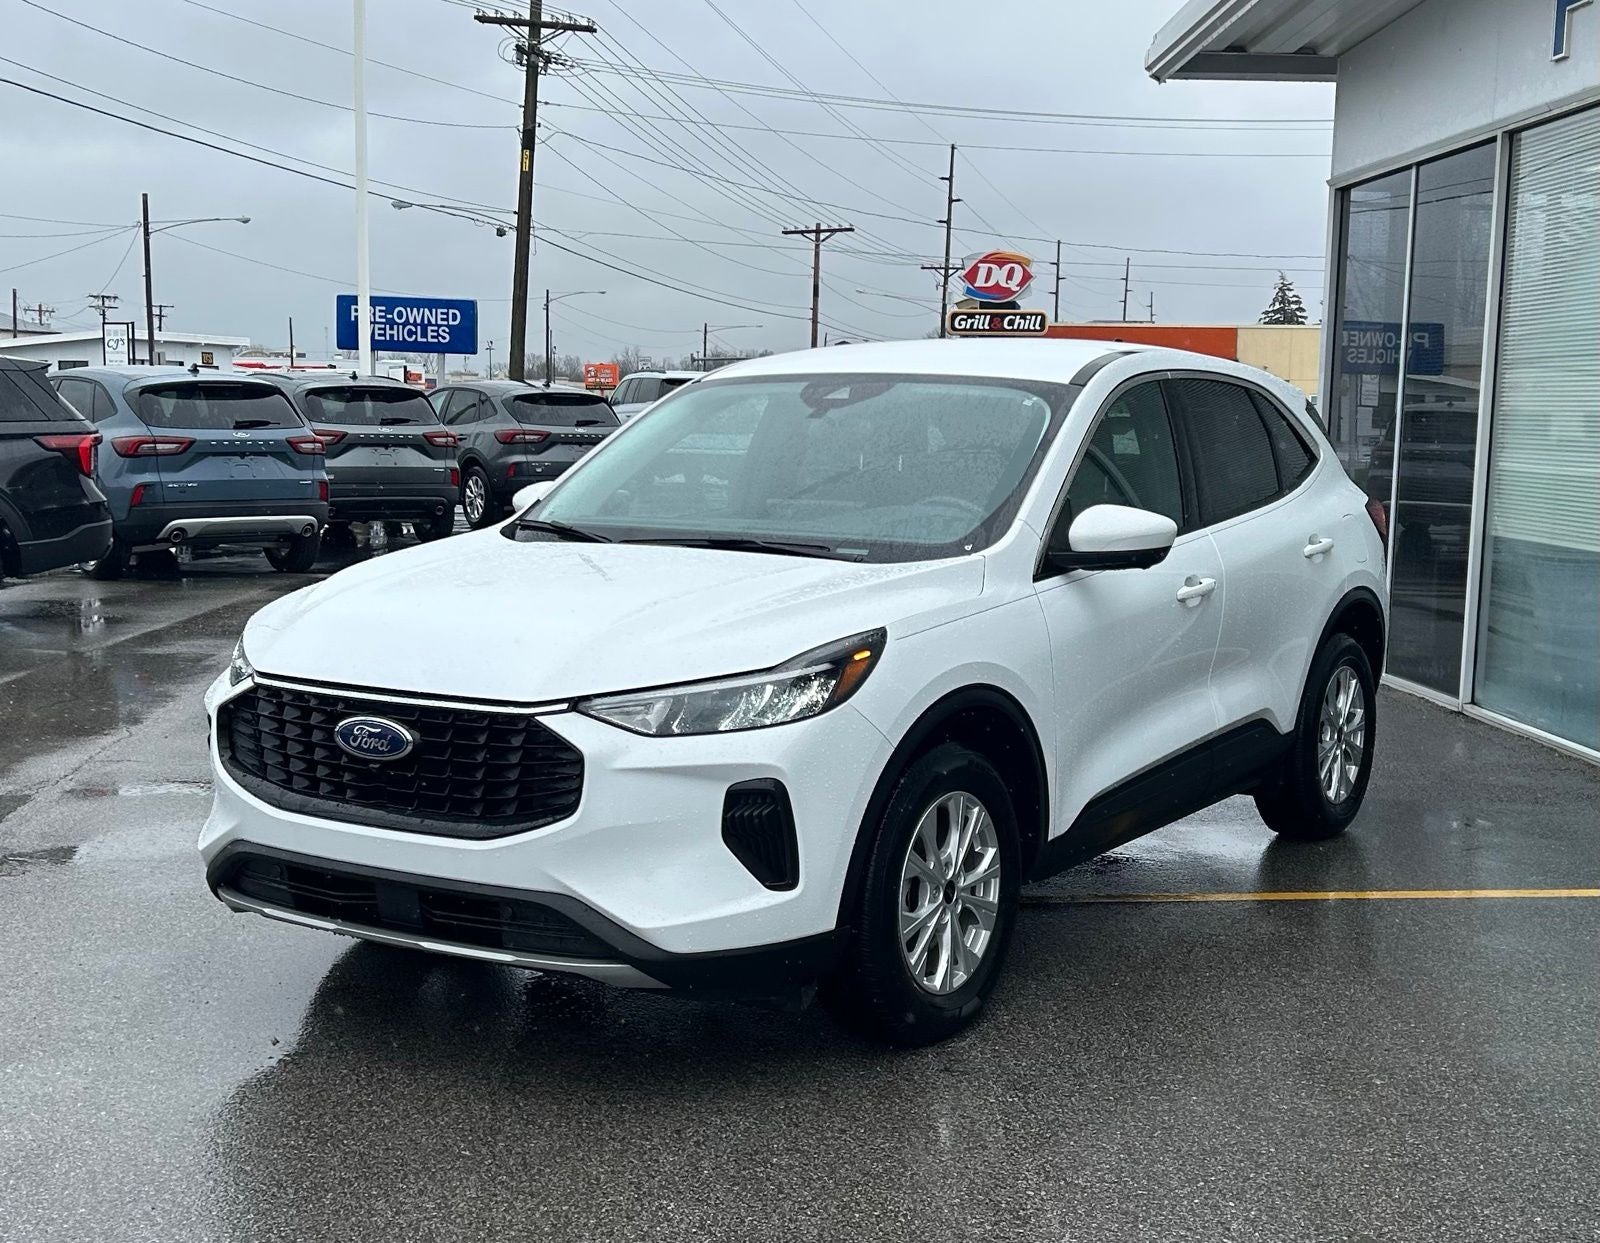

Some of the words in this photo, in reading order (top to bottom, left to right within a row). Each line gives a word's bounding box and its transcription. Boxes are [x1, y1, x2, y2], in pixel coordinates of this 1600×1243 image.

[974, 263, 1024, 292] DQ
[954, 315, 991, 330] Grill
[1003, 315, 1042, 330] Chill
[350, 725, 392, 752] Ford
